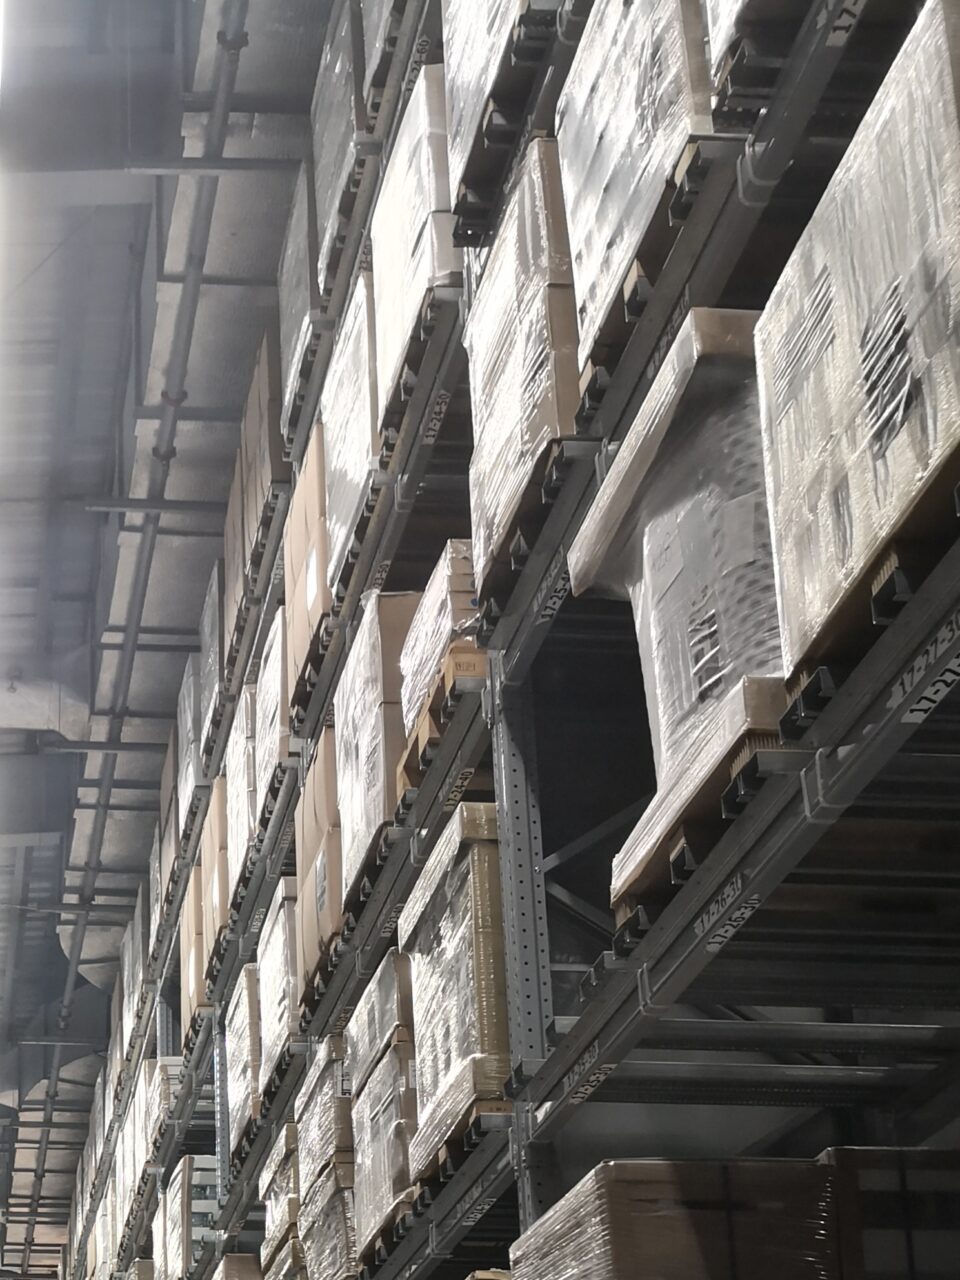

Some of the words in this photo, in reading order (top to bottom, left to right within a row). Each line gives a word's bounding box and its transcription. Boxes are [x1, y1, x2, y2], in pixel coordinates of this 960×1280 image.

[425, 393, 450, 438] 17-24-50
[444, 771, 473, 807] 17-24-40
[708, 898, 761, 946] 17-26-30
